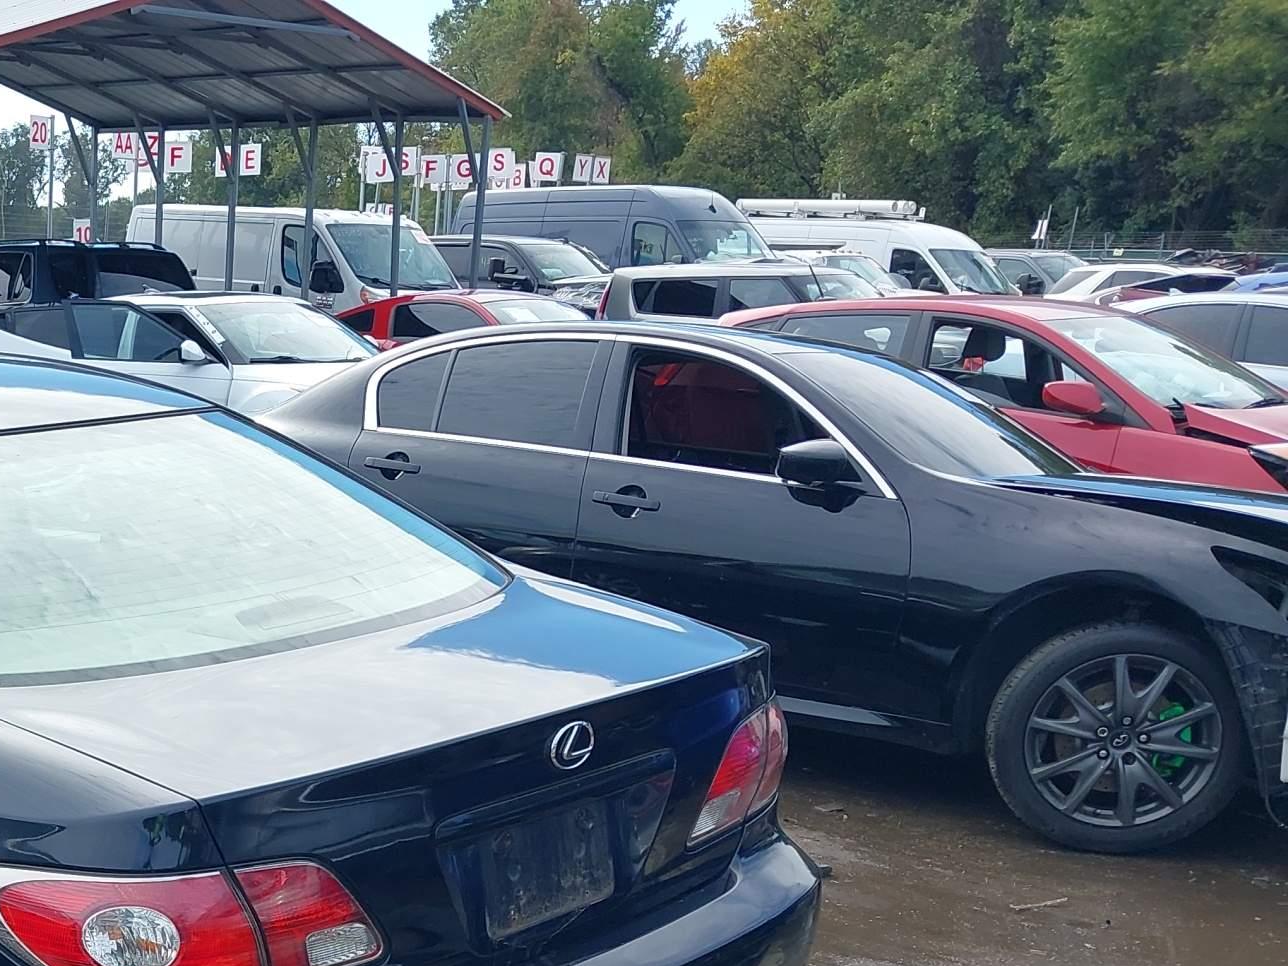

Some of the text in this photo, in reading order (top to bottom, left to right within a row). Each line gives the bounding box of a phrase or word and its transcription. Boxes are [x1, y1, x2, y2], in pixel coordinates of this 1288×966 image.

[31, 121, 48, 143] 20
[115, 131, 133, 154] AA
[170, 146, 184, 167] F
[245, 149, 256, 170] E
[493, 152, 505, 172] S
[375, 158, 387, 178] J
[425, 160, 438, 178] F
[456, 159, 473, 178] G
[539, 157, 555, 177] Q
[579, 158, 588, 177] Y
[596, 160, 607, 179] X
[76, 226, 92, 243] 10
